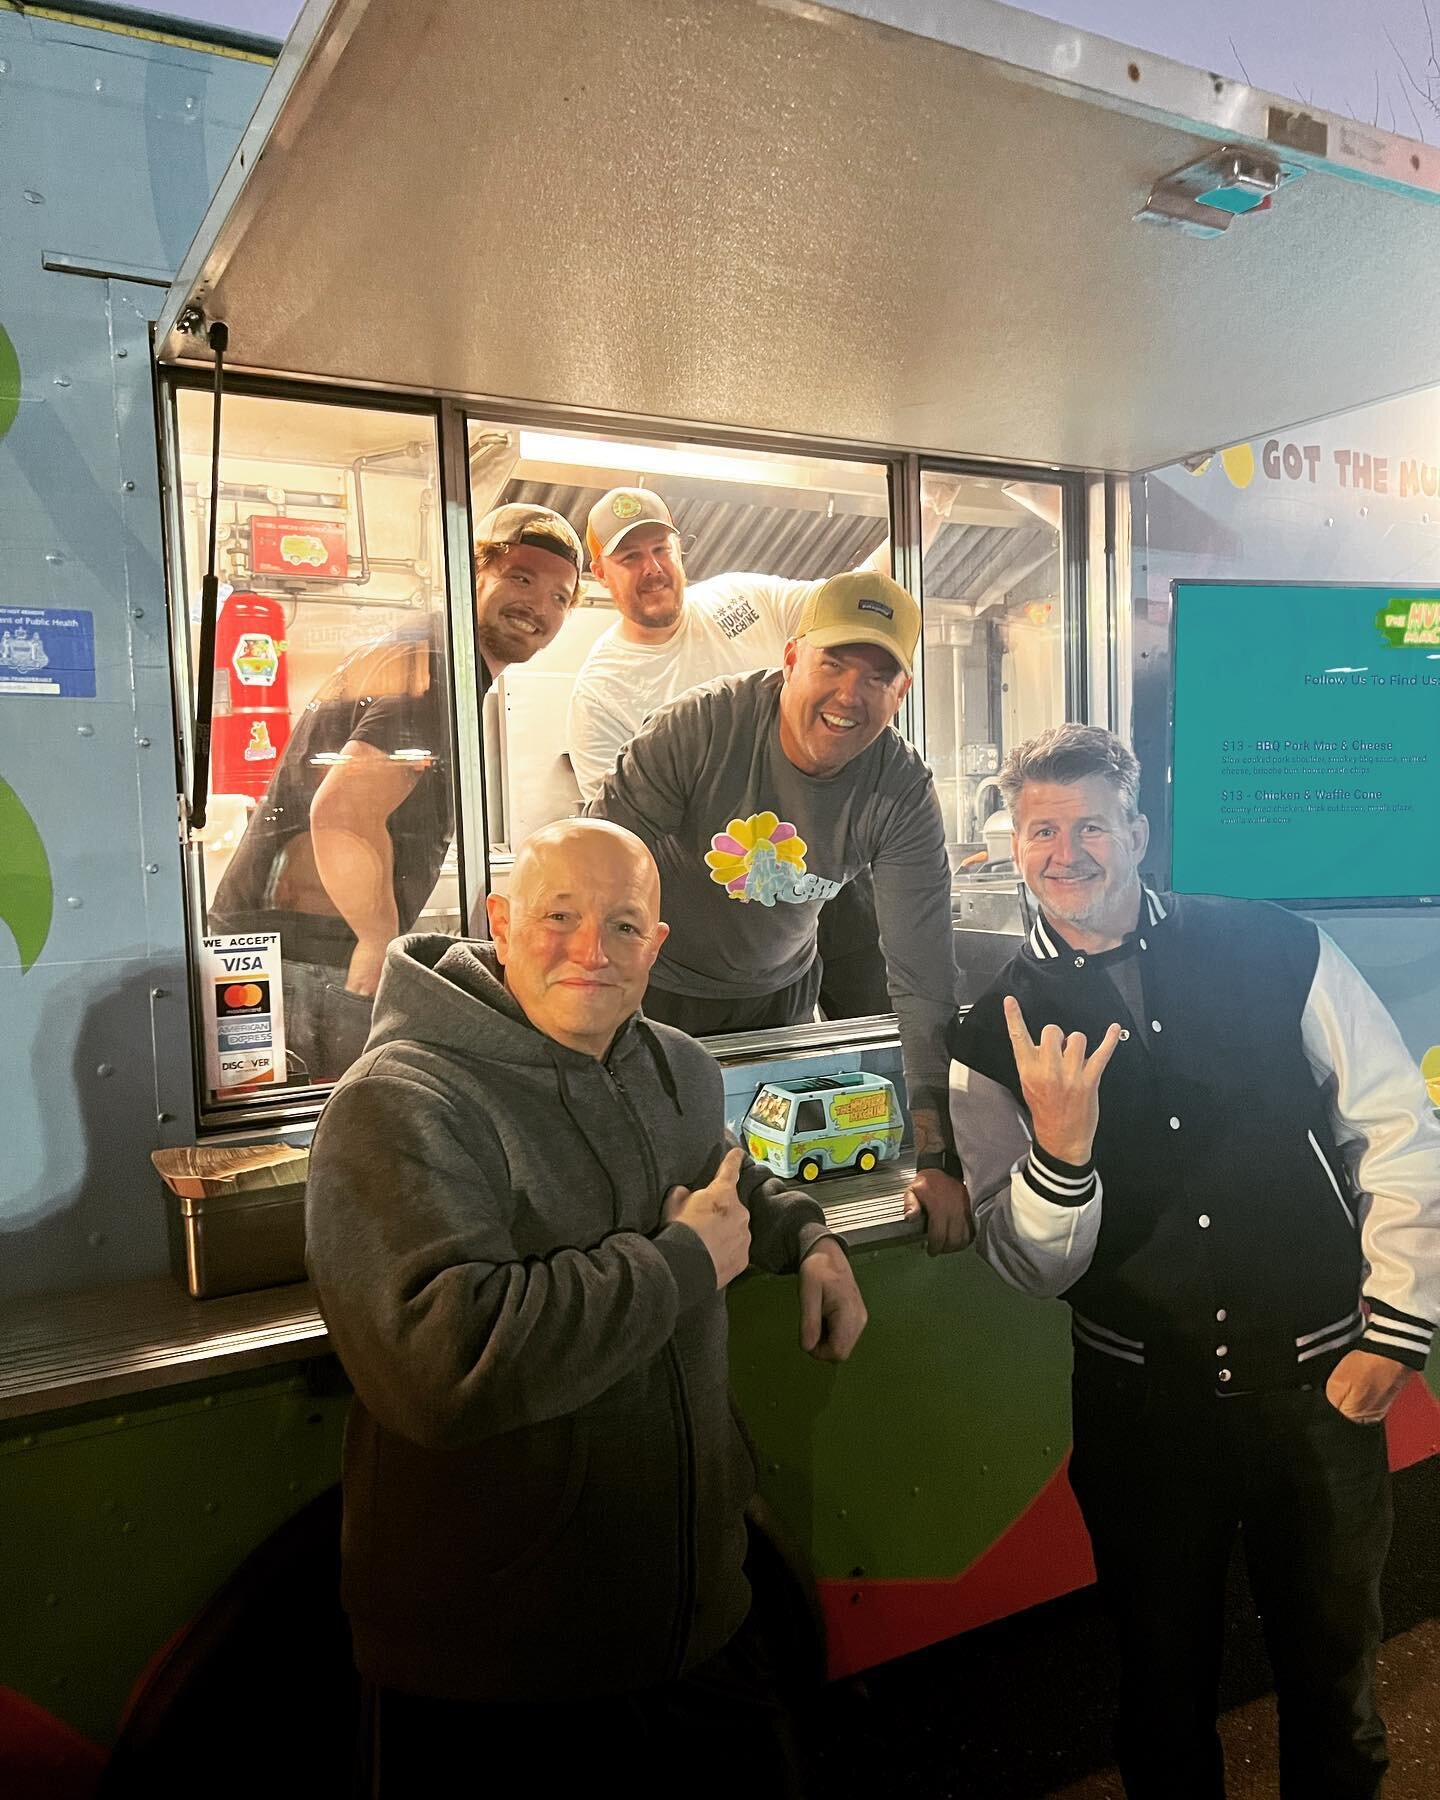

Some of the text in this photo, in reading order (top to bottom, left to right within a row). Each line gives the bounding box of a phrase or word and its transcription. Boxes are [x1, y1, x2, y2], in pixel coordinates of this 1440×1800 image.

[1262, 439, 1440, 498] GOT THE MU
[14, 617, 23, 625] of
[25, 617, 50, 626] Public
[52, 619, 79, 627] Health
[1304, 675, 1346, 685] Follow
[1351, 675, 1366, 685] Us
[1371, 675, 1385, 685] To
[1390, 675, 1418, 685] Find
[1222, 741, 1244, 752] $13
[1256, 740, 1280, 752] BBQ
[1284, 740, 1309, 751] Pork
[1313, 740, 1337, 751] Mac
[1352, 740, 1393, 751] Cheese
[1222, 790, 1243, 801] $13
[1254, 789, 1300, 801] Chicken
[1304, 789, 1311, 801] &
[1315, 789, 1351, 800] Waffle
[1354, 789, 1382, 800] Cone
[203, 935, 277, 948] WE ACCEPT
[220, 956, 262, 972] VISA
[218, 1022, 270, 1035] AMERICAN
[228, 1032, 272, 1044] EXPRESS
